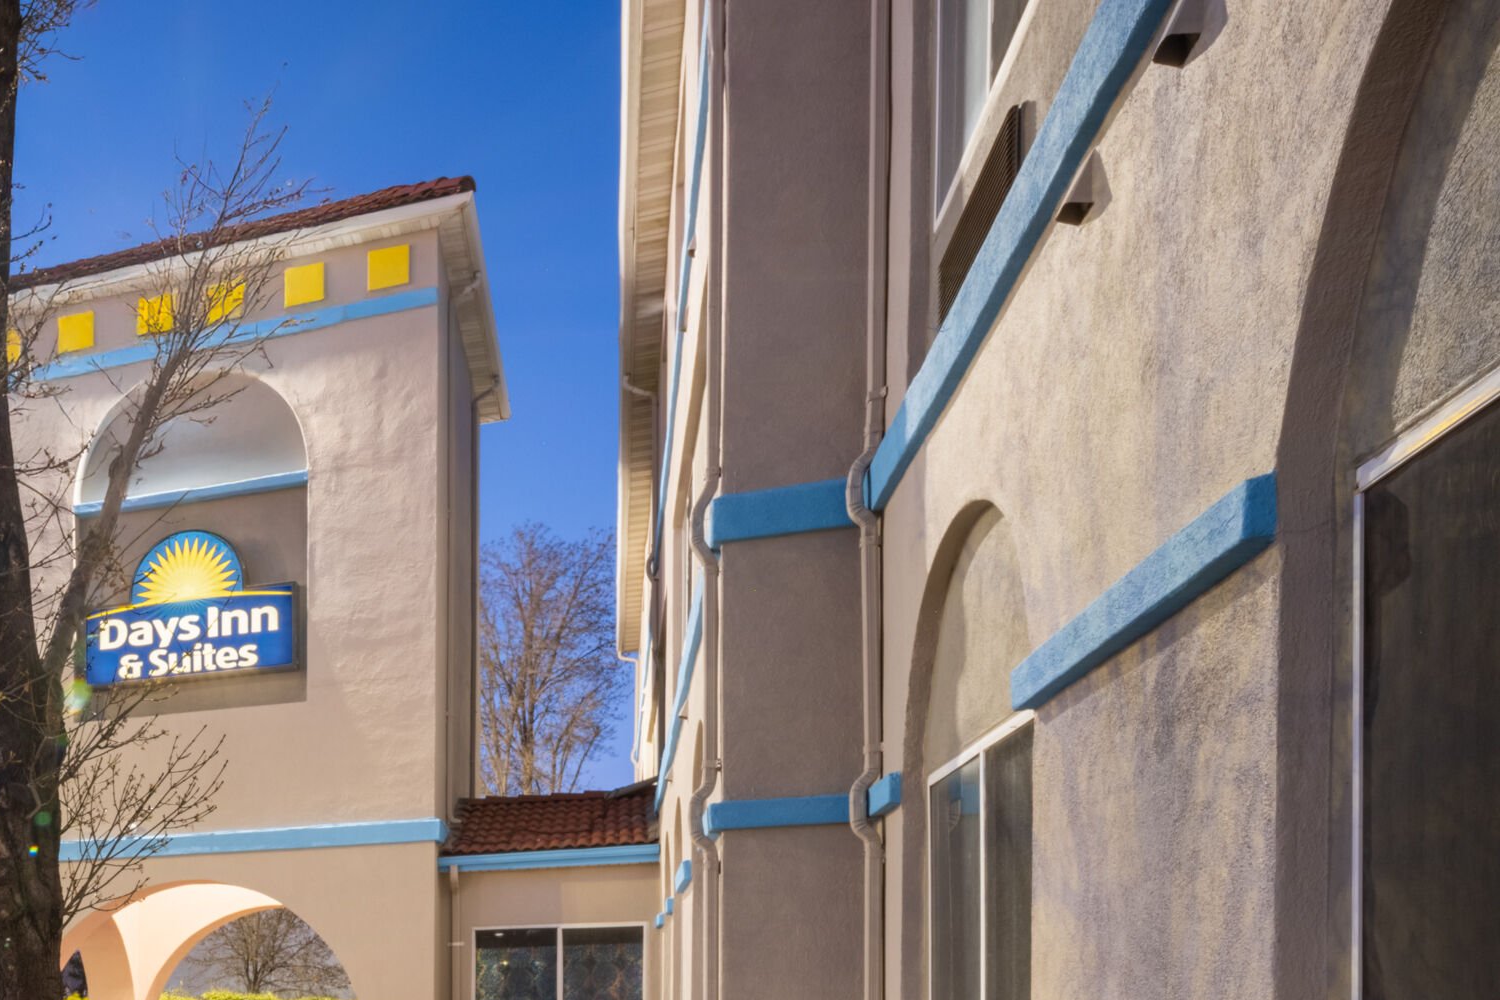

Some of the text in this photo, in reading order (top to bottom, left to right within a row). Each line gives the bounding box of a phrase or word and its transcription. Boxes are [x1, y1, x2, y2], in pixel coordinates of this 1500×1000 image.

[98, 605, 279, 651] Days Inn
[118, 642, 258, 679] & Suites
